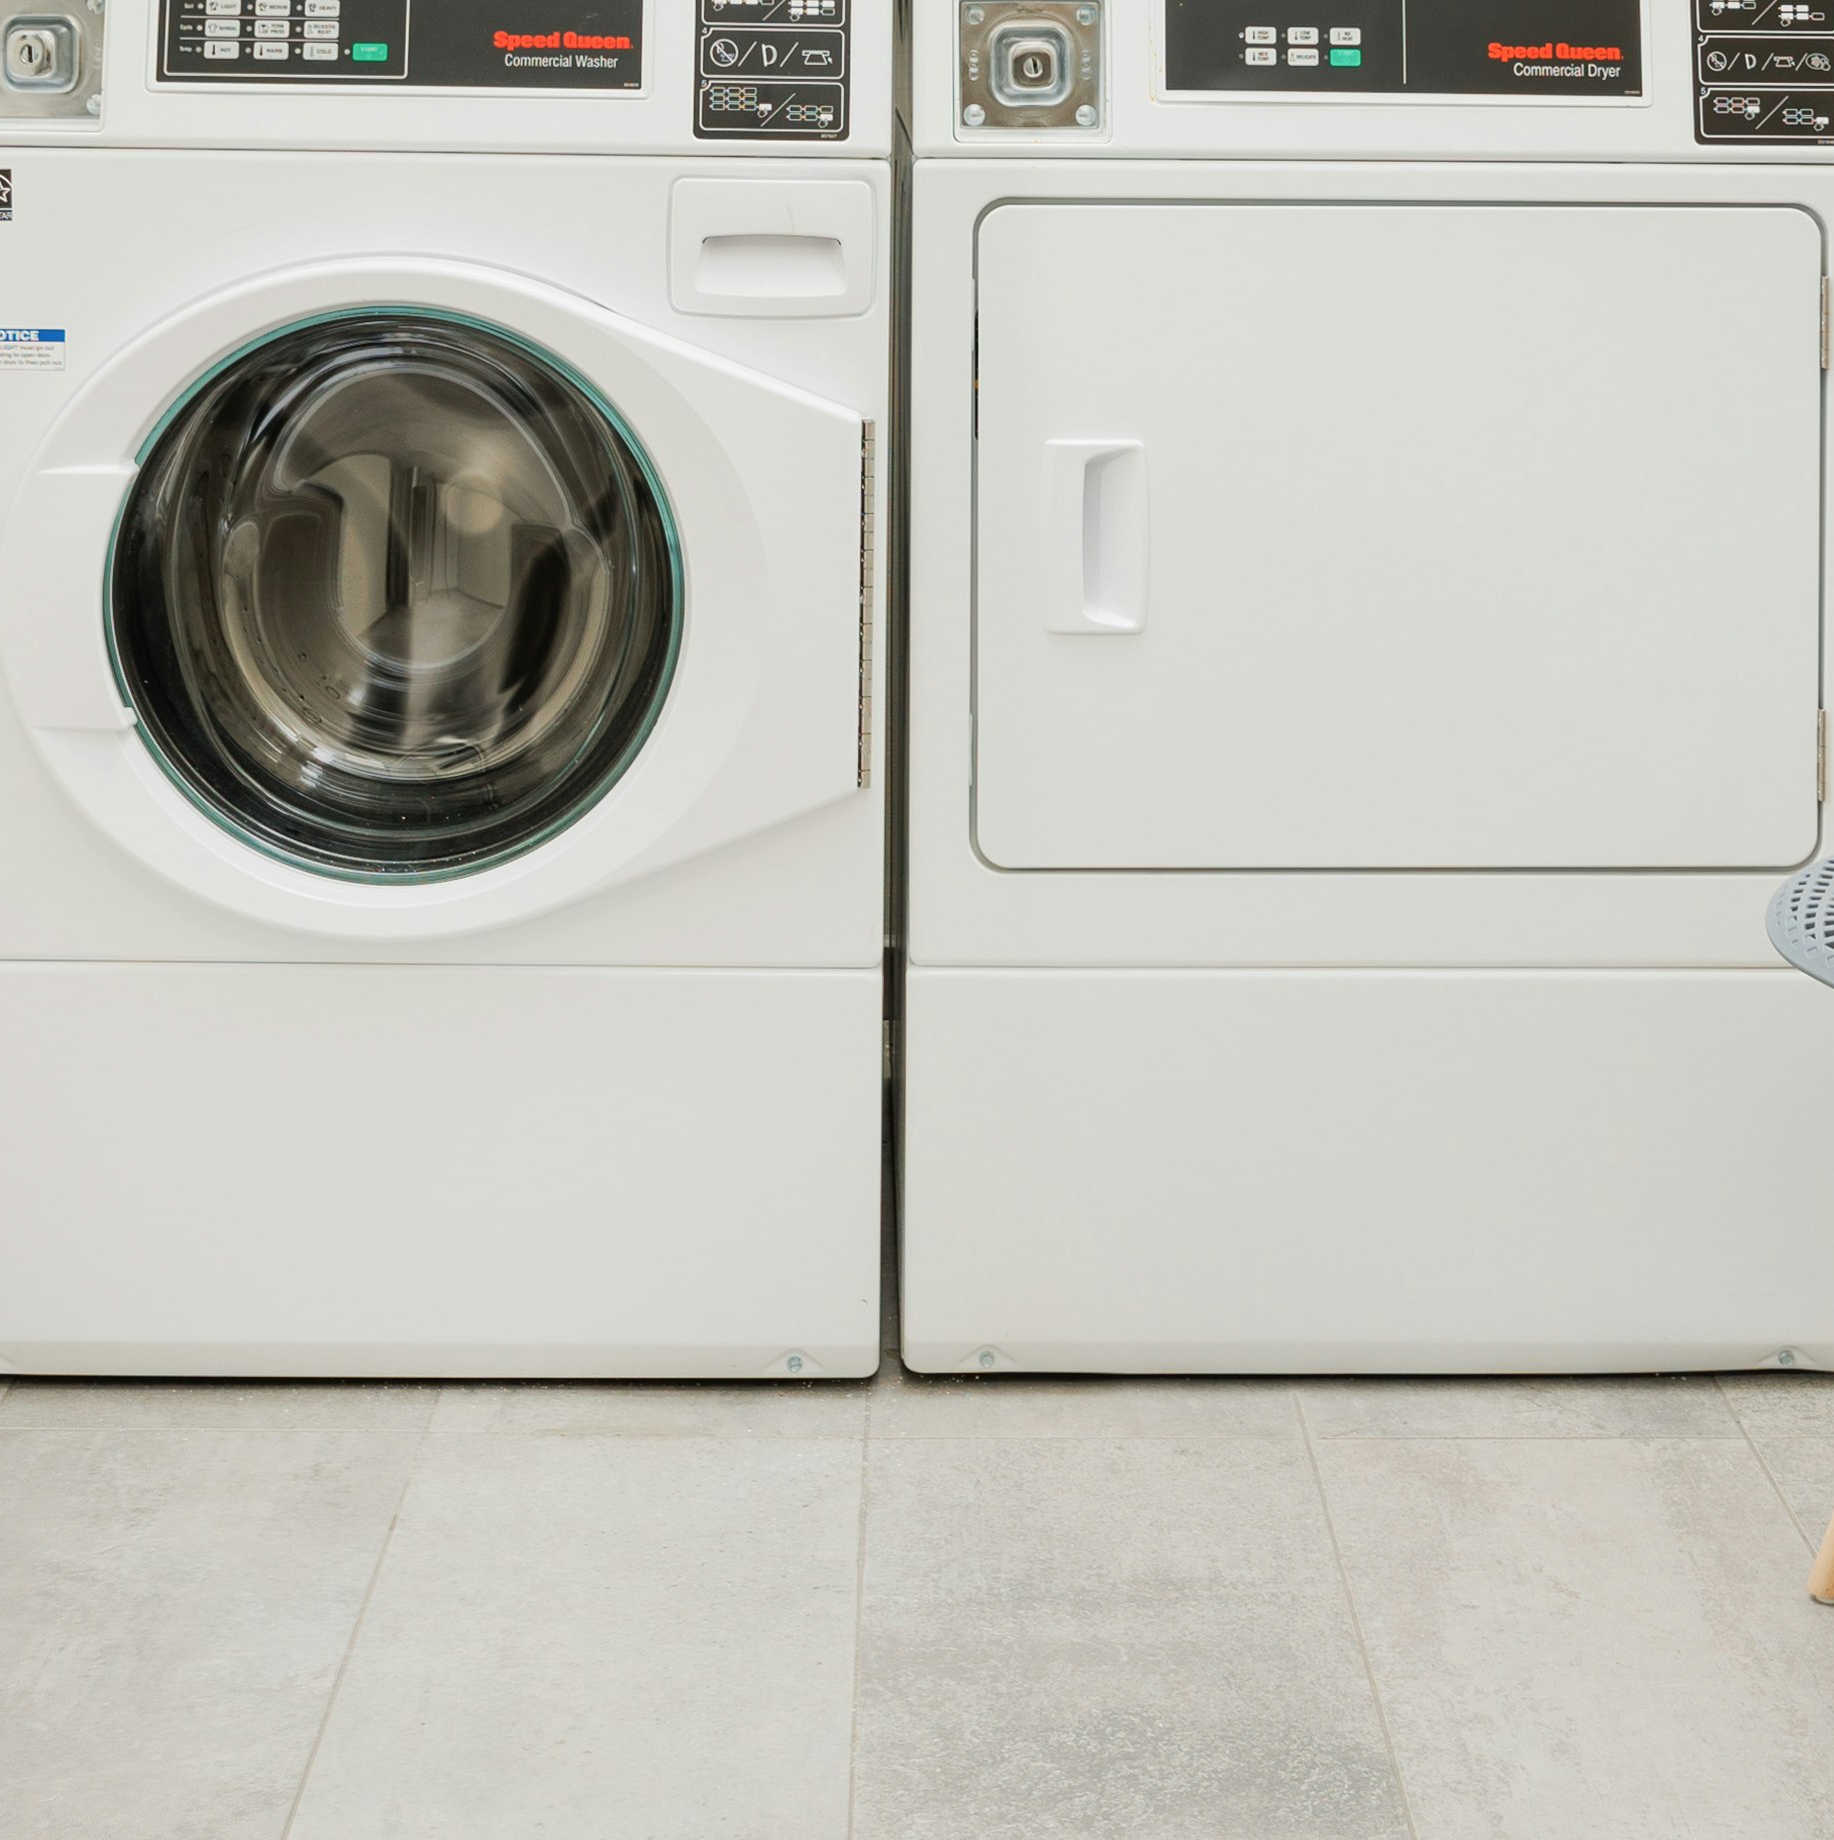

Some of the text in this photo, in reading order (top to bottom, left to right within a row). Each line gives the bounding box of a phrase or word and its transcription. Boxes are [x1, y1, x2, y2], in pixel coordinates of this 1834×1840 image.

[493, 30, 630, 51] Speed Queen
[504, 53, 619, 69] Commercial Washer
[1488, 42, 1622, 62] Speed Queen
[1513, 62, 1621, 80] Commercial Dryer
[1700, 86, 1707, 95] 5
